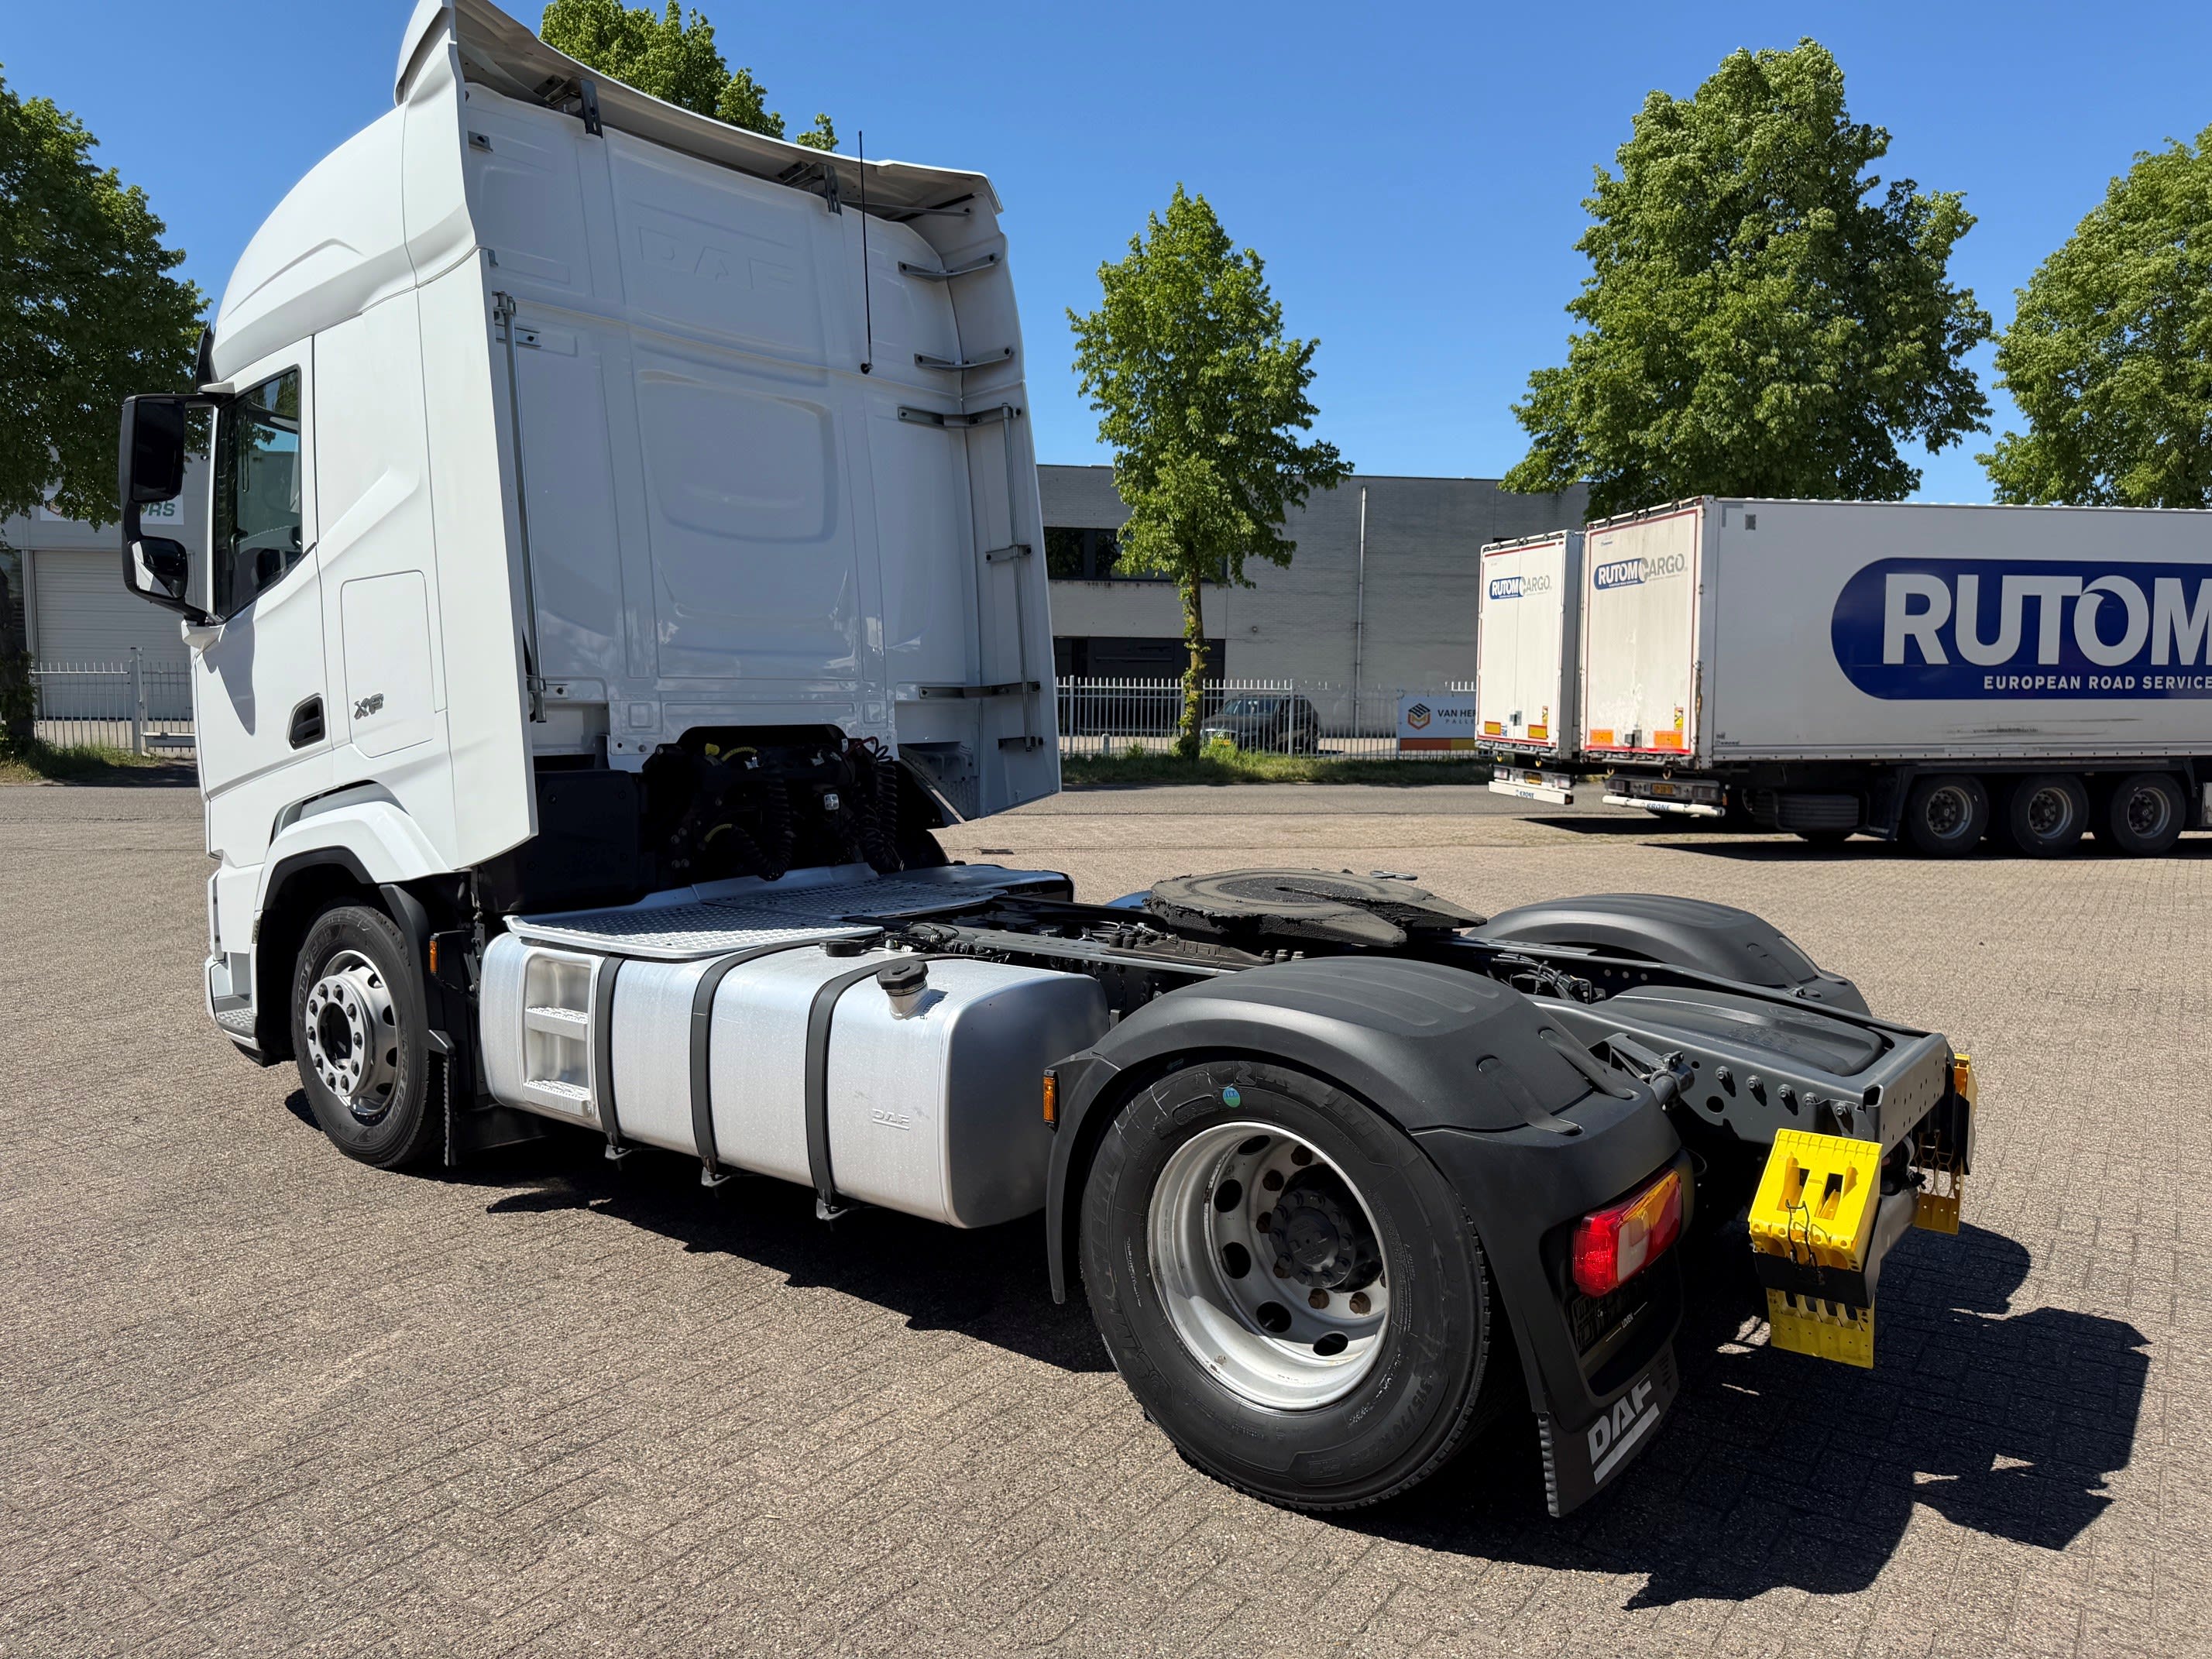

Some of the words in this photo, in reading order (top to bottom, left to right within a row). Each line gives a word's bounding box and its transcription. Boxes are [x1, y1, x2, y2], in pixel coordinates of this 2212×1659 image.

[637, 225, 795, 291] DAF
[1598, 560, 1638, 586] RUTOM
[1638, 552, 1685, 582] CARGO
[1492, 579, 1519, 596] RUTOM
[1882, 573, 2212, 666] RUTOM
[1984, 675, 2081, 690] EUROPEAN
[2088, 675, 2136, 690] ROAD
[2142, 675, 2212, 690] SERVICE
[354, 692, 384, 720] XF
[1437, 709, 1458, 717] VAN
[1647, 802, 1671, 812] KRONE
[871, 1108, 910, 1124] DAF
[1587, 1373, 1653, 1465] DAF
